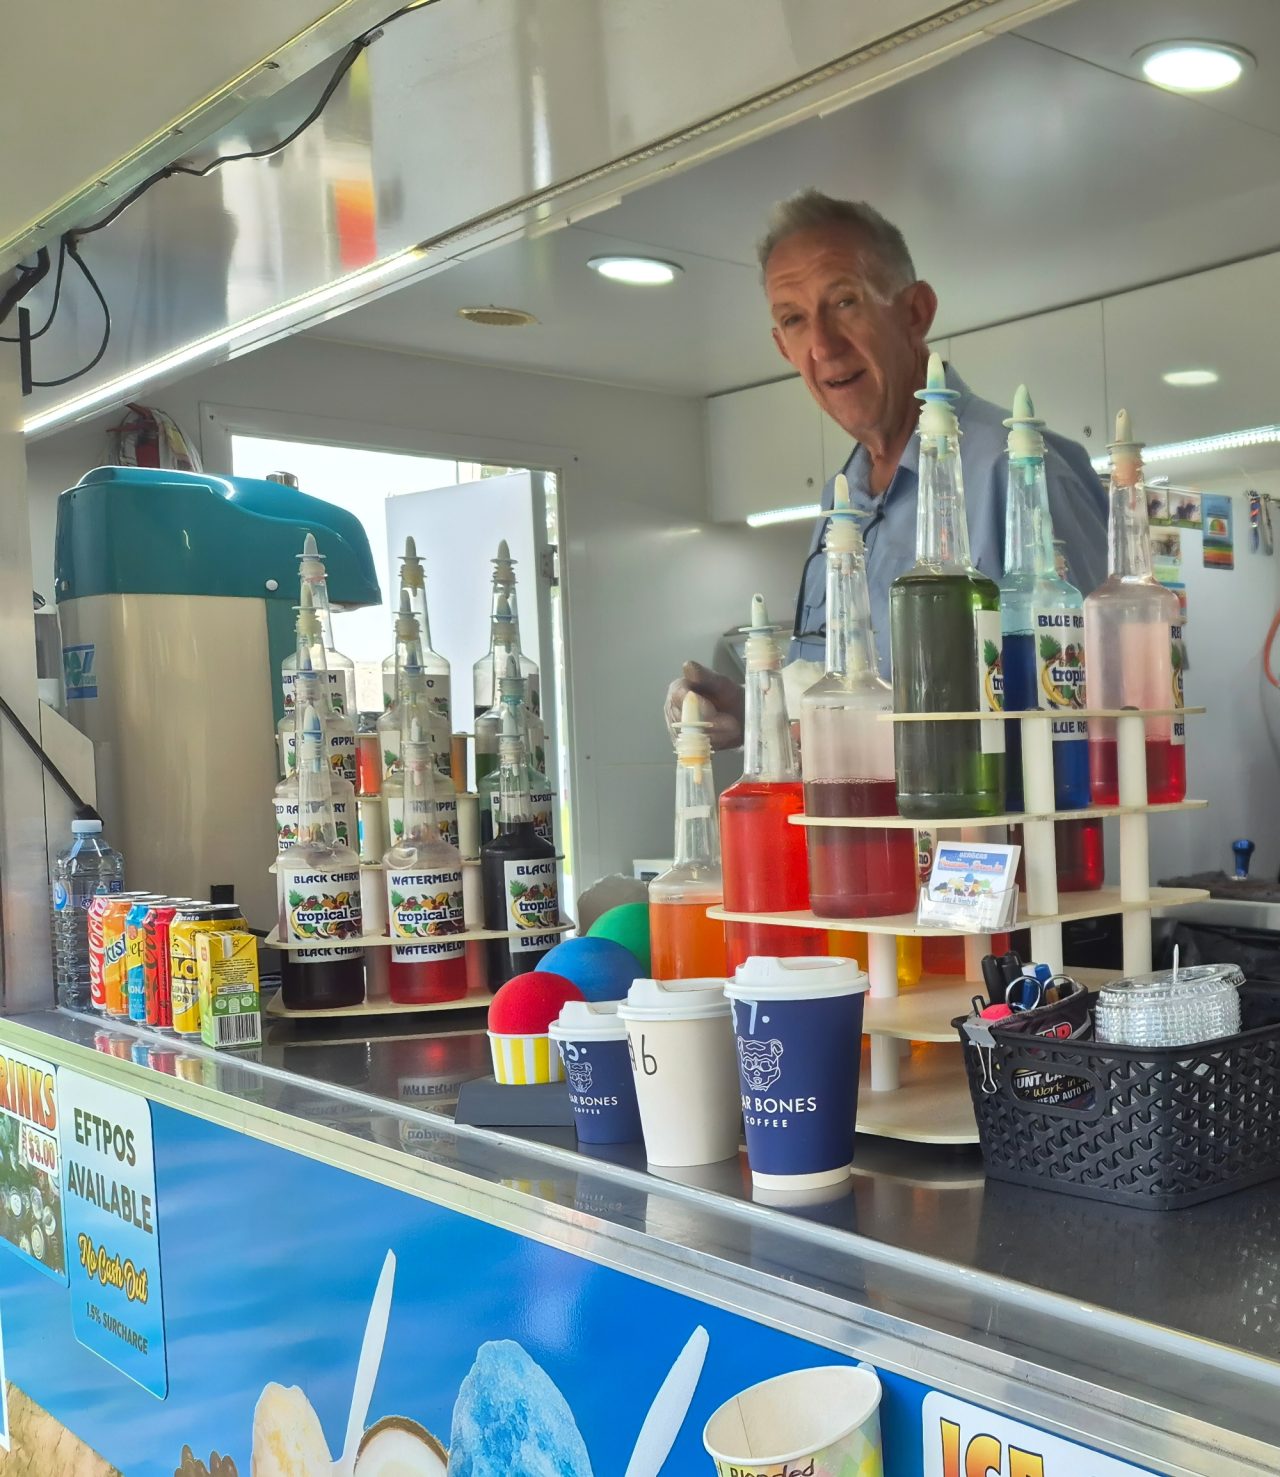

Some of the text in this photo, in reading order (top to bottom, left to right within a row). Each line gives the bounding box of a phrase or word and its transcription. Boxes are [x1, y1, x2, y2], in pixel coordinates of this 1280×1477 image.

[1038, 615, 1070, 627] BLUE
[1052, 721, 1075, 733] LUE
[516, 863, 550, 875] BLACK
[294, 874, 327, 884] BLACK
[297, 907, 348, 924] tropical
[398, 907, 447, 924] tropical
[520, 934, 555, 947] BLACK
[297, 947, 332, 957] BLACK
[1015, 1074, 1042, 1088] UNT
[1033, 1083, 1063, 1097] Work
[1062, 1087, 1082, 1100] AUTO
[580, 1096, 618, 1106] BONES
[755, 1097, 817, 1113] BONES
[745, 1116, 788, 1127] COFFEE
[74, 1107, 136, 1167] EFTPOS
[28, 1130, 56, 1170] $3.00
[67, 1159, 153, 1234] AVAILABLE
[78, 1232, 149, 1305] No Cash Out
[86, 1302, 148, 1356] 1.5% SURCHARGE
